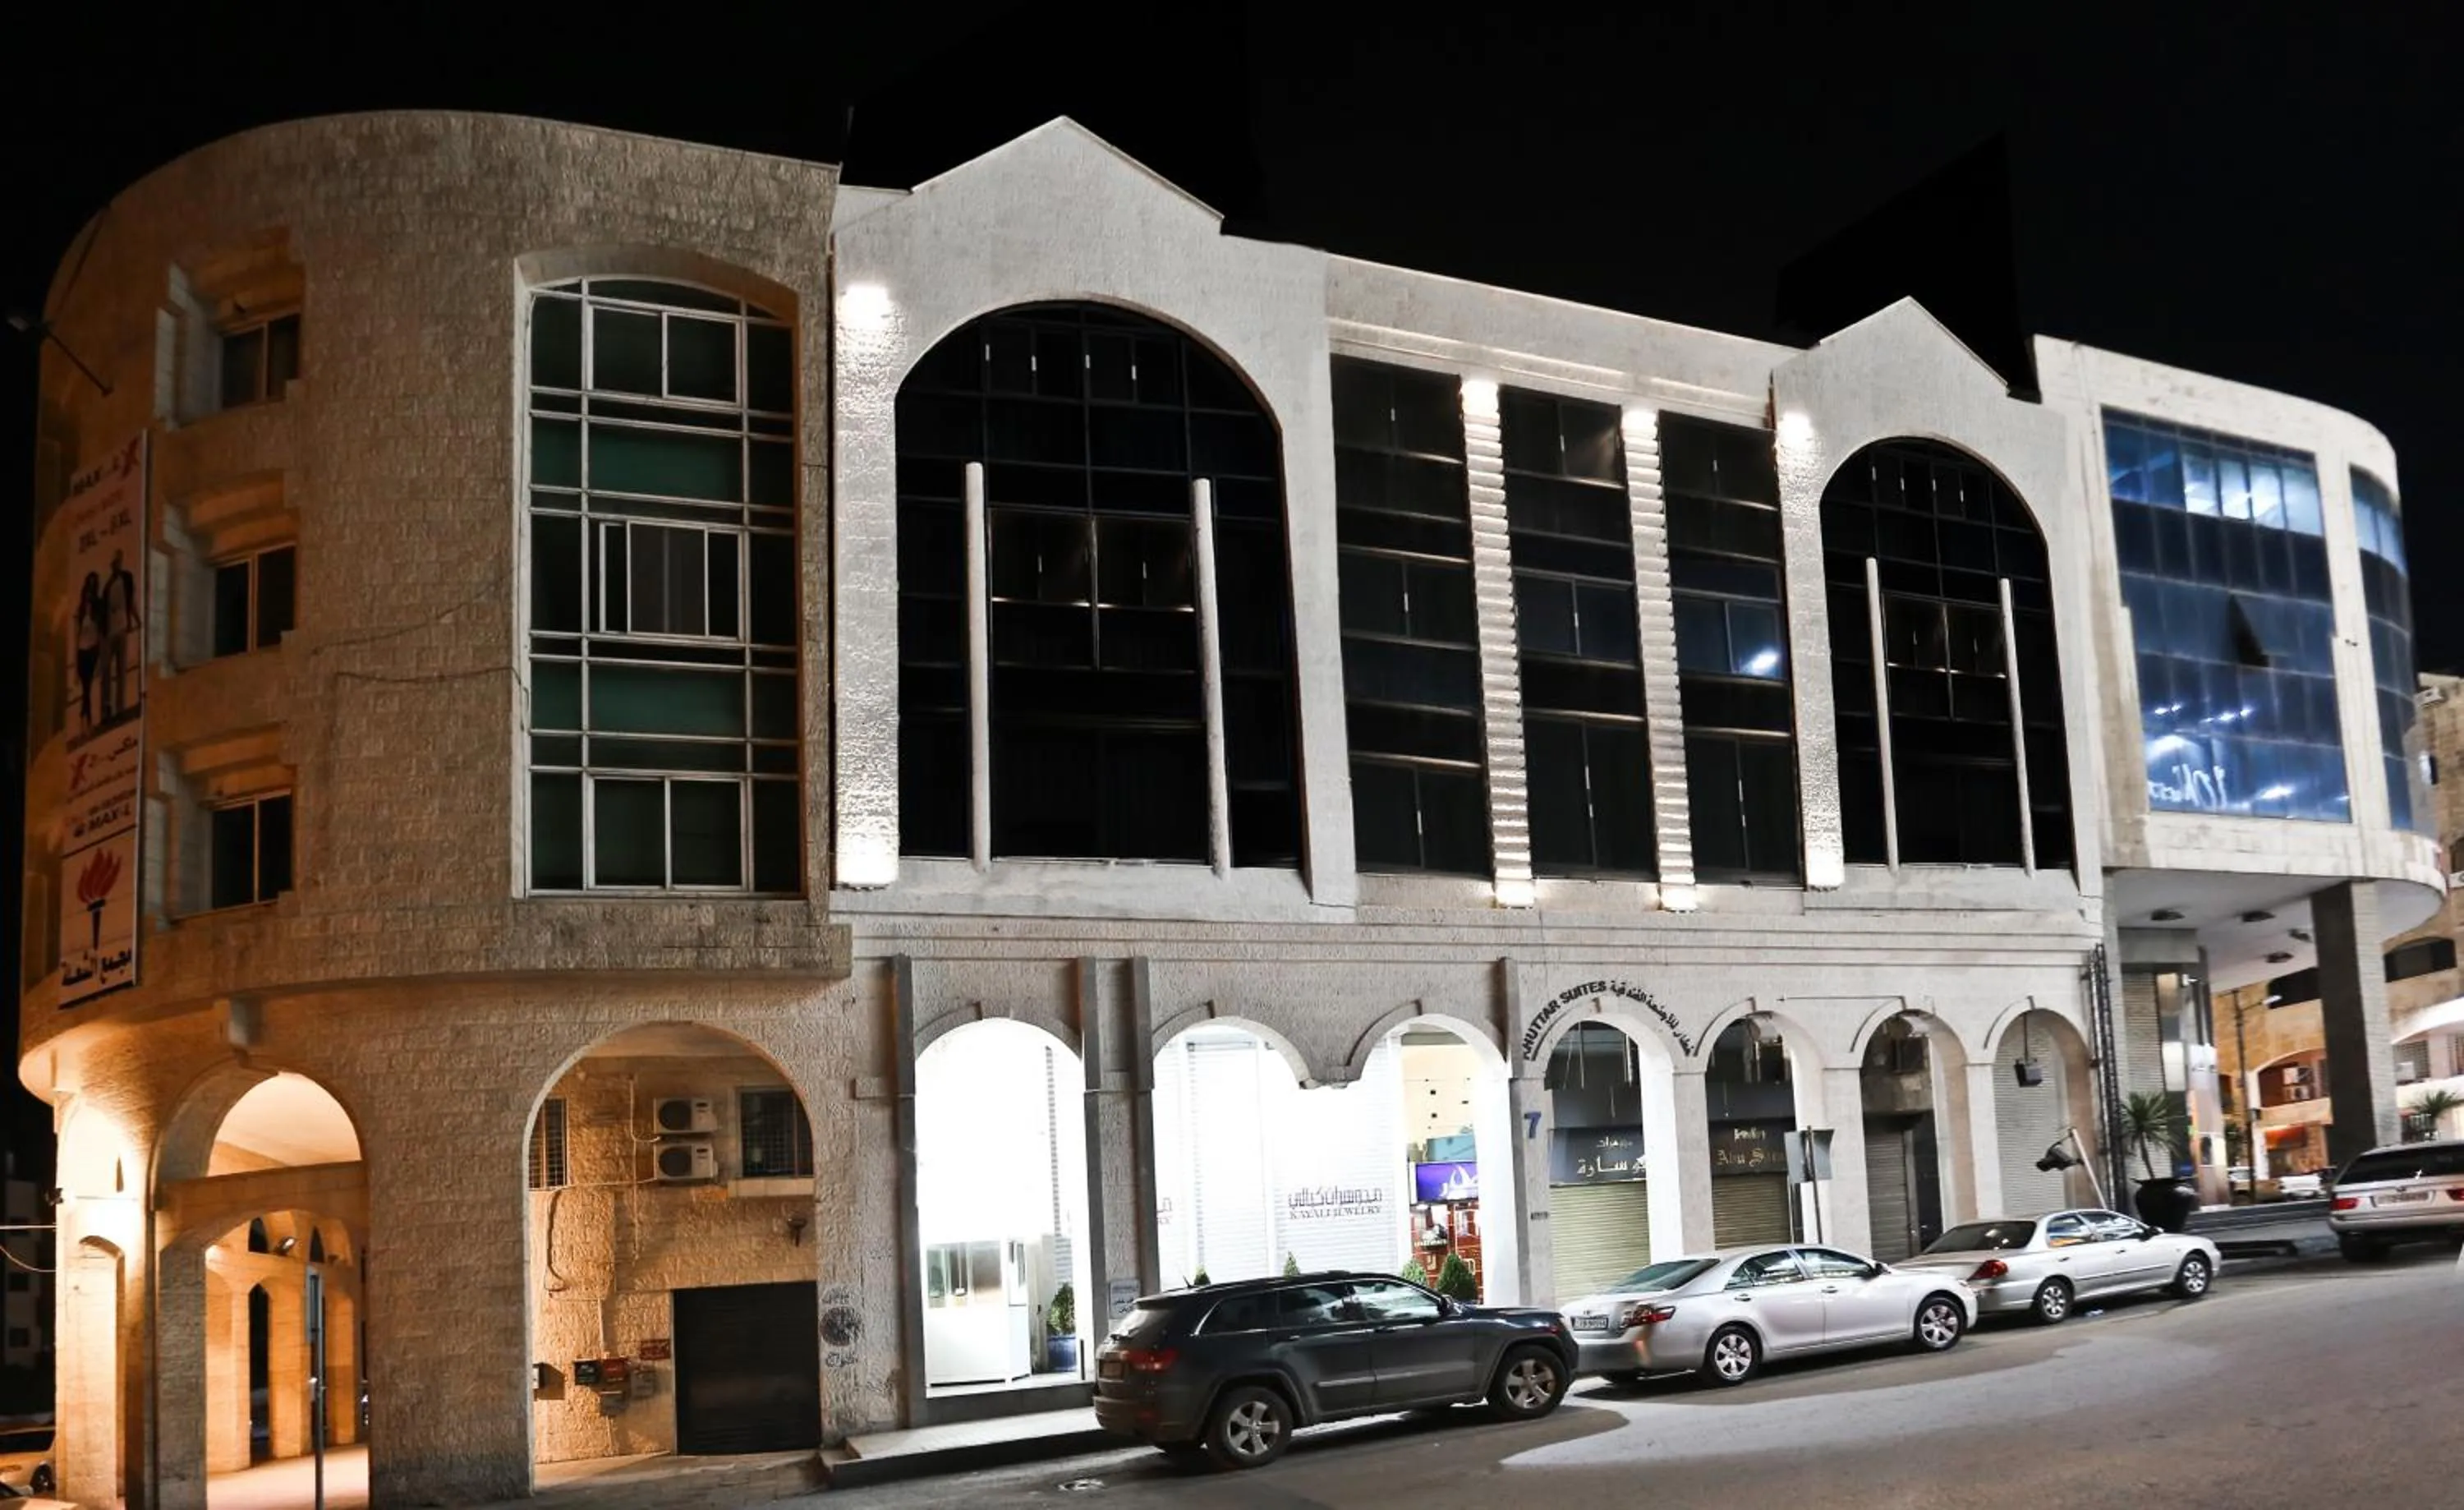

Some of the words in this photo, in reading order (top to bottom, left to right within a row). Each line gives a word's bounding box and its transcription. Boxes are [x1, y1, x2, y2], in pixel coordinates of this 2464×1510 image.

[1559, 981, 1607, 1004] SUITES
[1524, 1111, 1542, 1139] 7
[1576, 1155, 1628, 1177] سارة
[1288, 1208, 1331, 1220] KAYALI
[1332, 1204, 1381, 1218] JEWELRY
